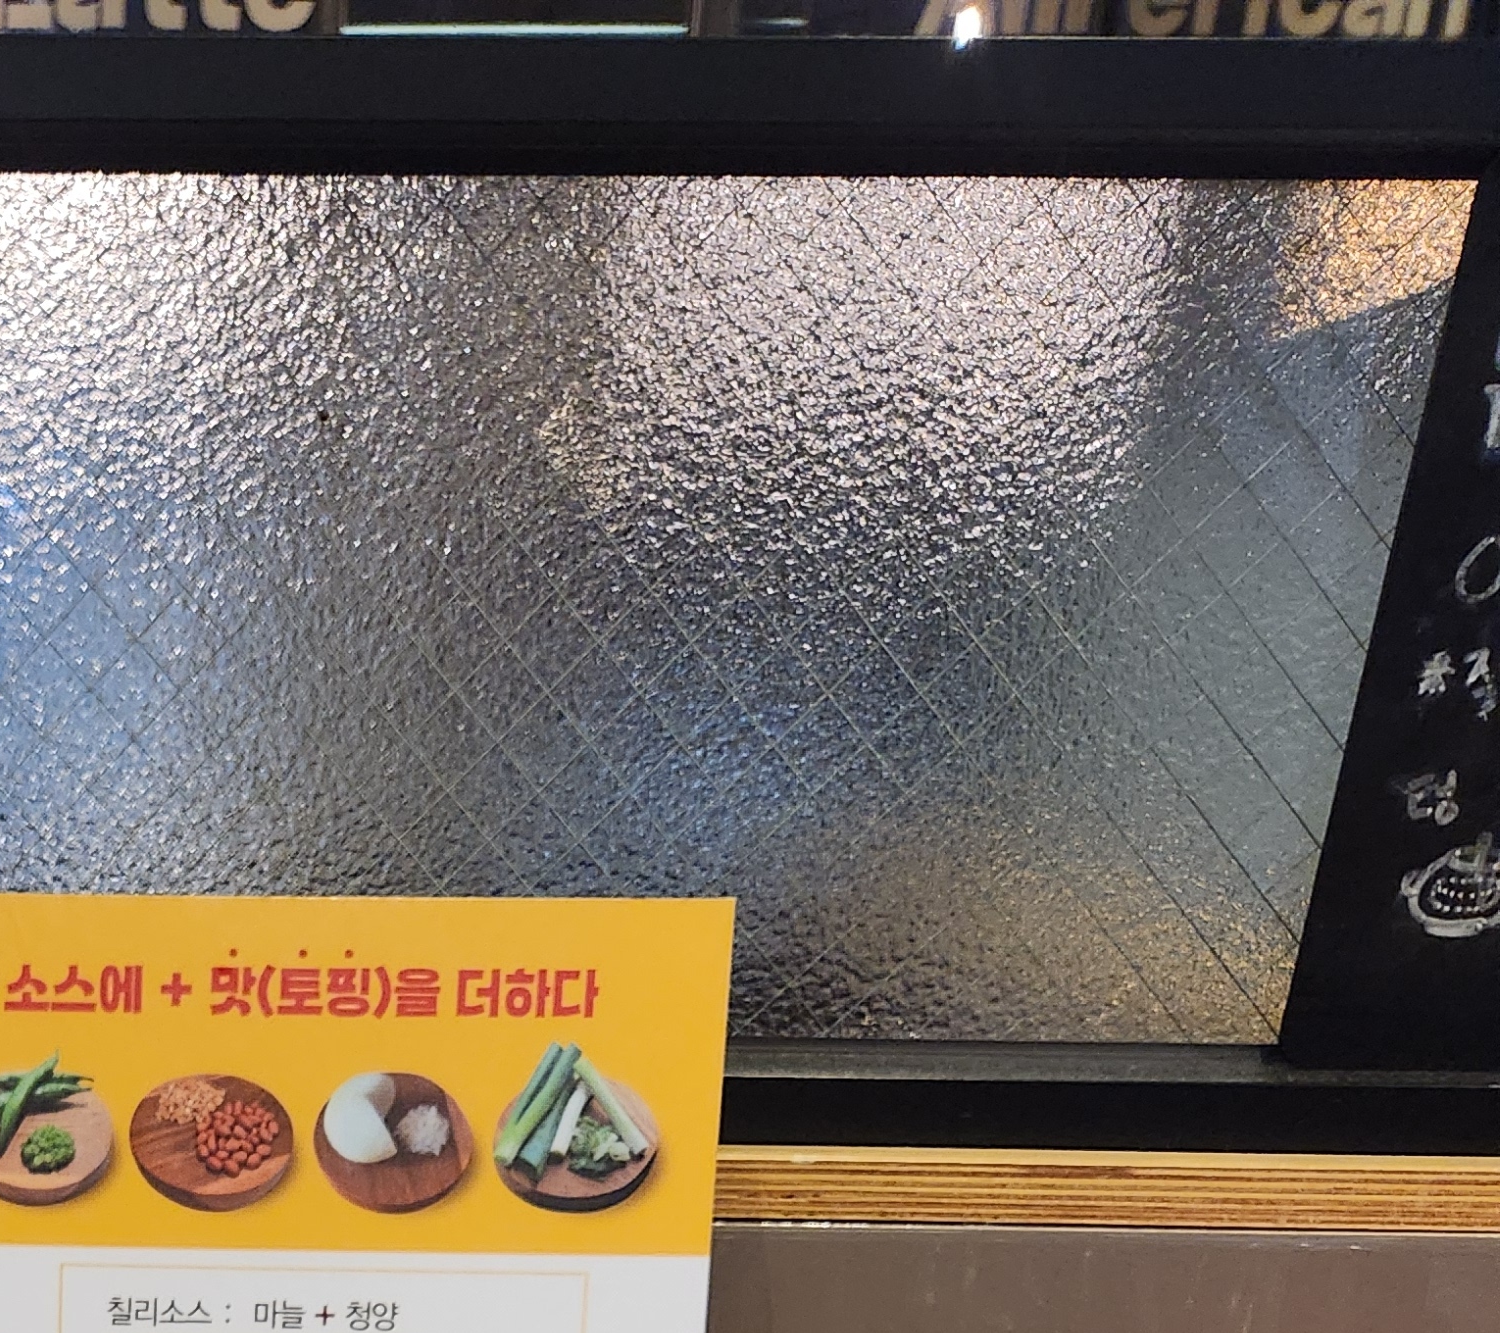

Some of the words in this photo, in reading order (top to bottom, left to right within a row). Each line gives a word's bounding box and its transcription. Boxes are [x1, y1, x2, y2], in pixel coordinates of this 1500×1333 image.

[3, 963, 145, 1014] 소스에
[160, 972, 193, 1007] +
[210, 964, 441, 1019] 맛(토핑)을
[455, 967, 600, 1019] 더하다
[106, 1296, 213, 1327] 칠리소스
[253, 1299, 308, 1330] 마늘
[314, 1304, 336, 1327] +
[345, 1300, 400, 1332] 청양
